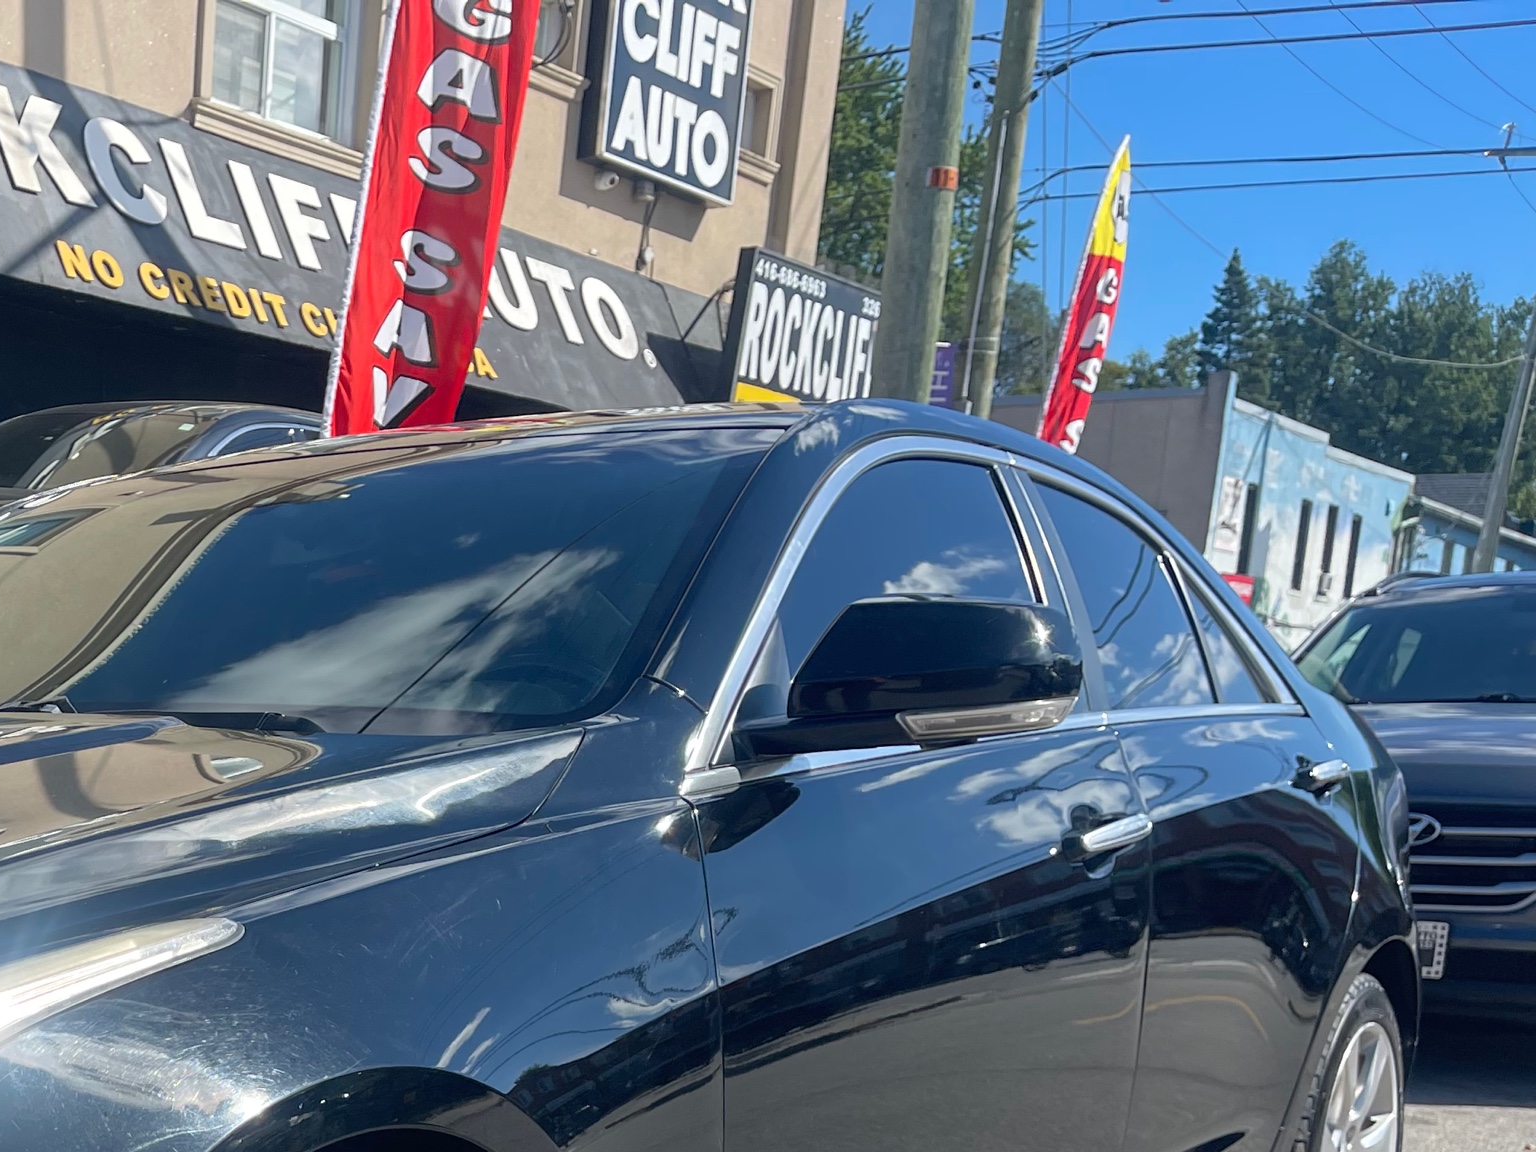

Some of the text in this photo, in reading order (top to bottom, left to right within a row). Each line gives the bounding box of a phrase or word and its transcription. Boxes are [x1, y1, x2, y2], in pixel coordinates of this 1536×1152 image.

[623, 0, 741, 98] CLIFF
[610, 75, 730, 188] AUTO
[56, 240, 124, 289] NO
[138, 261, 290, 328] CREDIT
[482, 247, 639, 361] UTO
[1071, 267, 1119, 394] GAS
